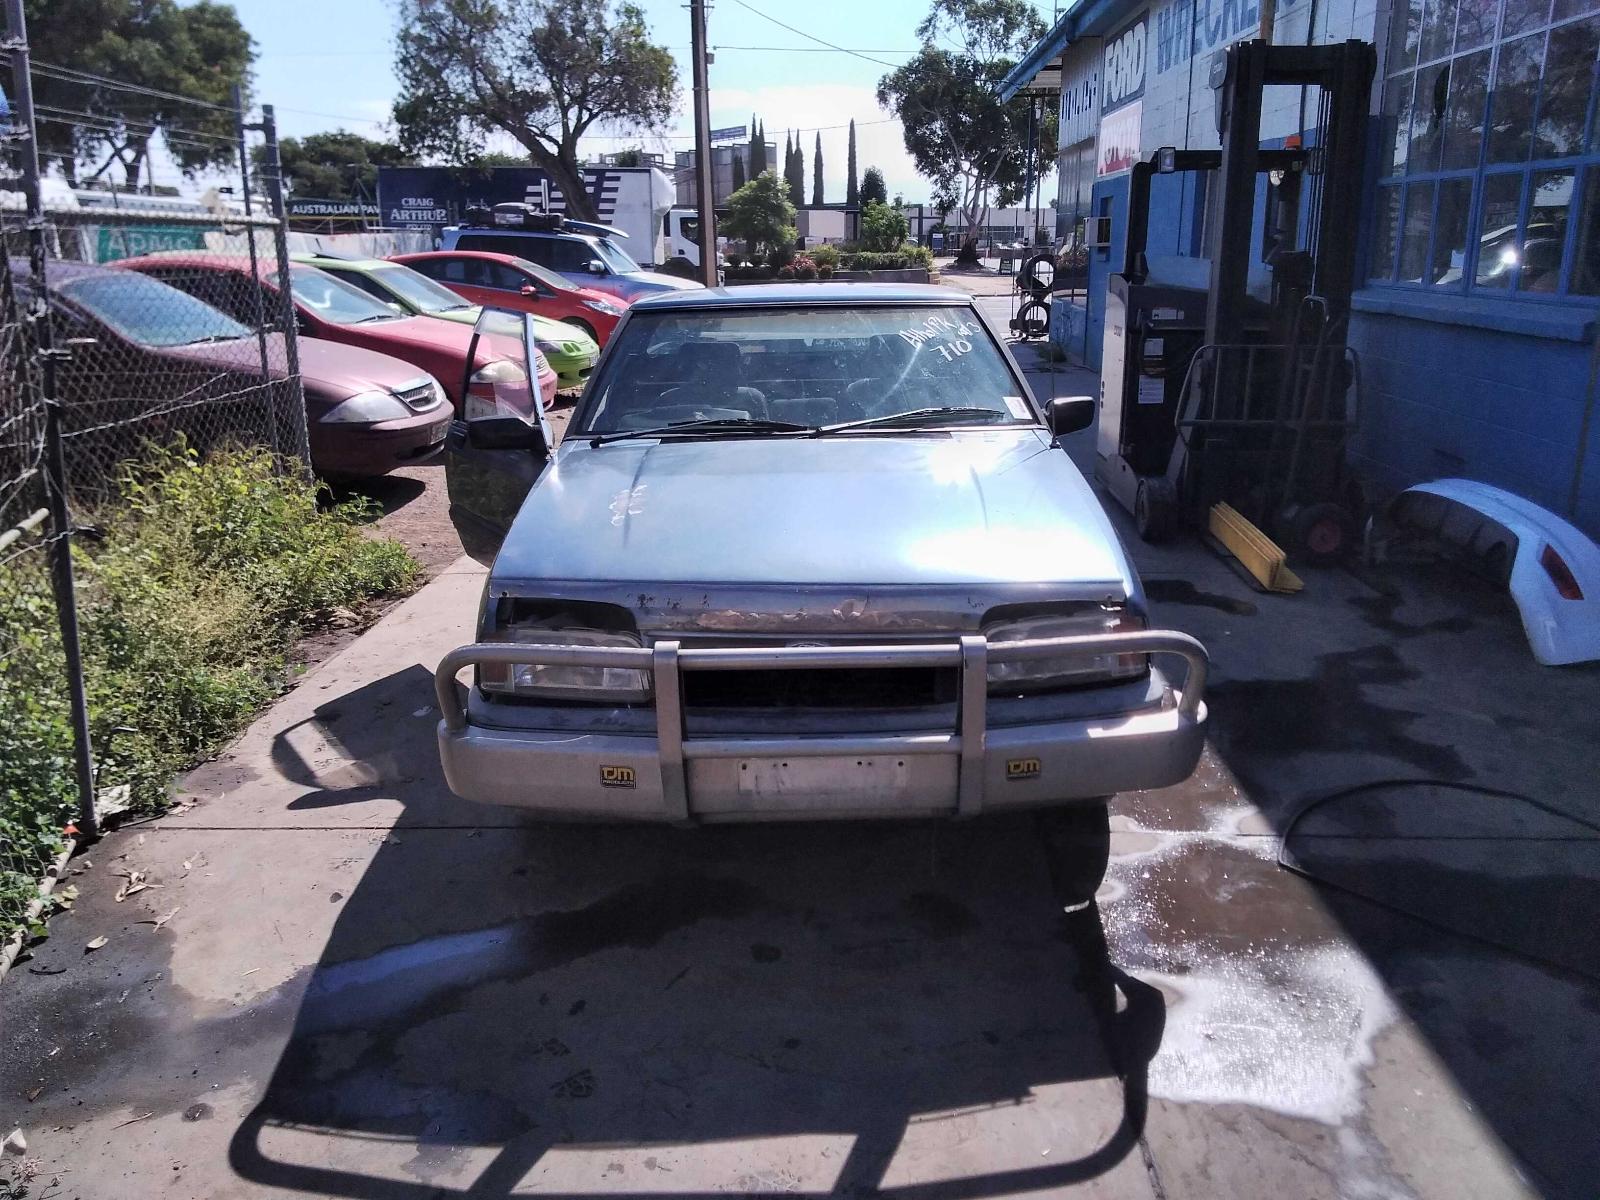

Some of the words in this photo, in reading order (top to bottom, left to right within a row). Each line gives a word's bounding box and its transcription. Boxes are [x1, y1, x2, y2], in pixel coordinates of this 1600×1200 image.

[1103, 22, 1147, 108] FORD
[291, 204, 360, 215] AUSTRALIAN
[401, 198, 434, 207] CRAIG
[928, 340, 973, 362] 710
